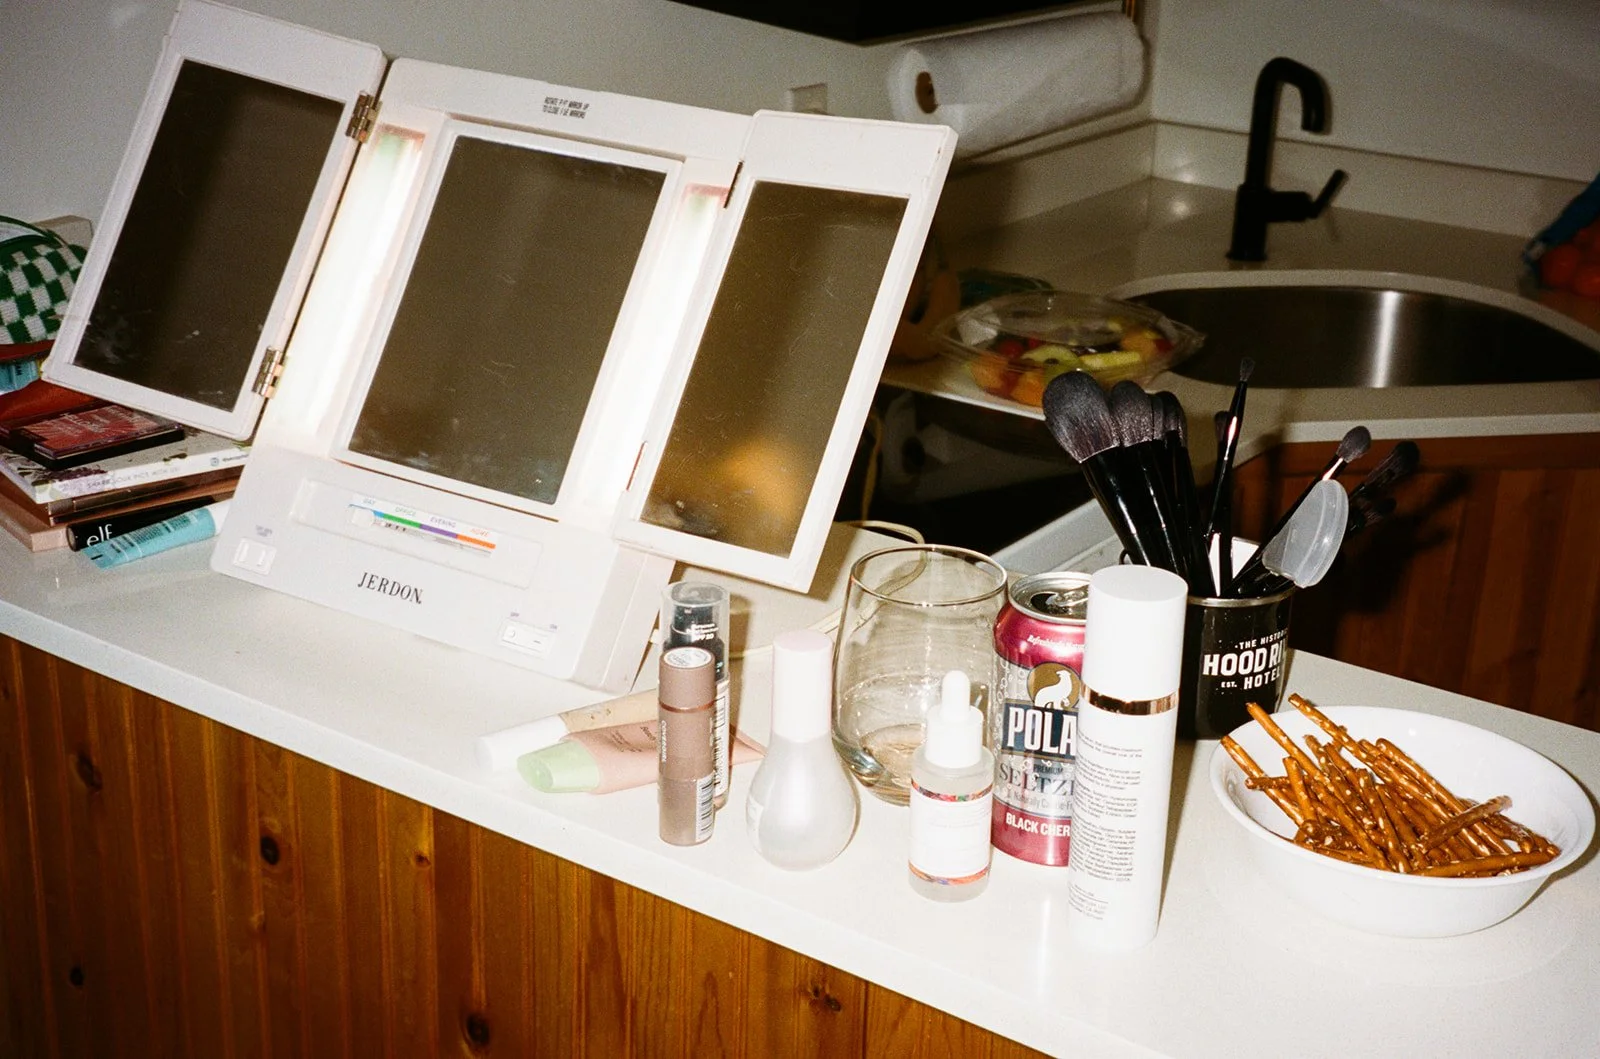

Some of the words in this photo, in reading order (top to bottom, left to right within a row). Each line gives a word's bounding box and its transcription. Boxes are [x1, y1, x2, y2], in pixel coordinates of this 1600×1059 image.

[395, 506, 417, 518] OFFICE
[430, 516, 458, 529] EVENING
[86, 523, 113, 547] elf
[1239, 638, 1257, 650] THE
[1202, 647, 1267, 676] HOOD
[1221, 680, 1238, 689] EST.
[1243, 667, 1281, 690] HOTEL
[1033, 763, 1064, 774] PREMIUM
[1005, 812, 1040, 834] BLACK
